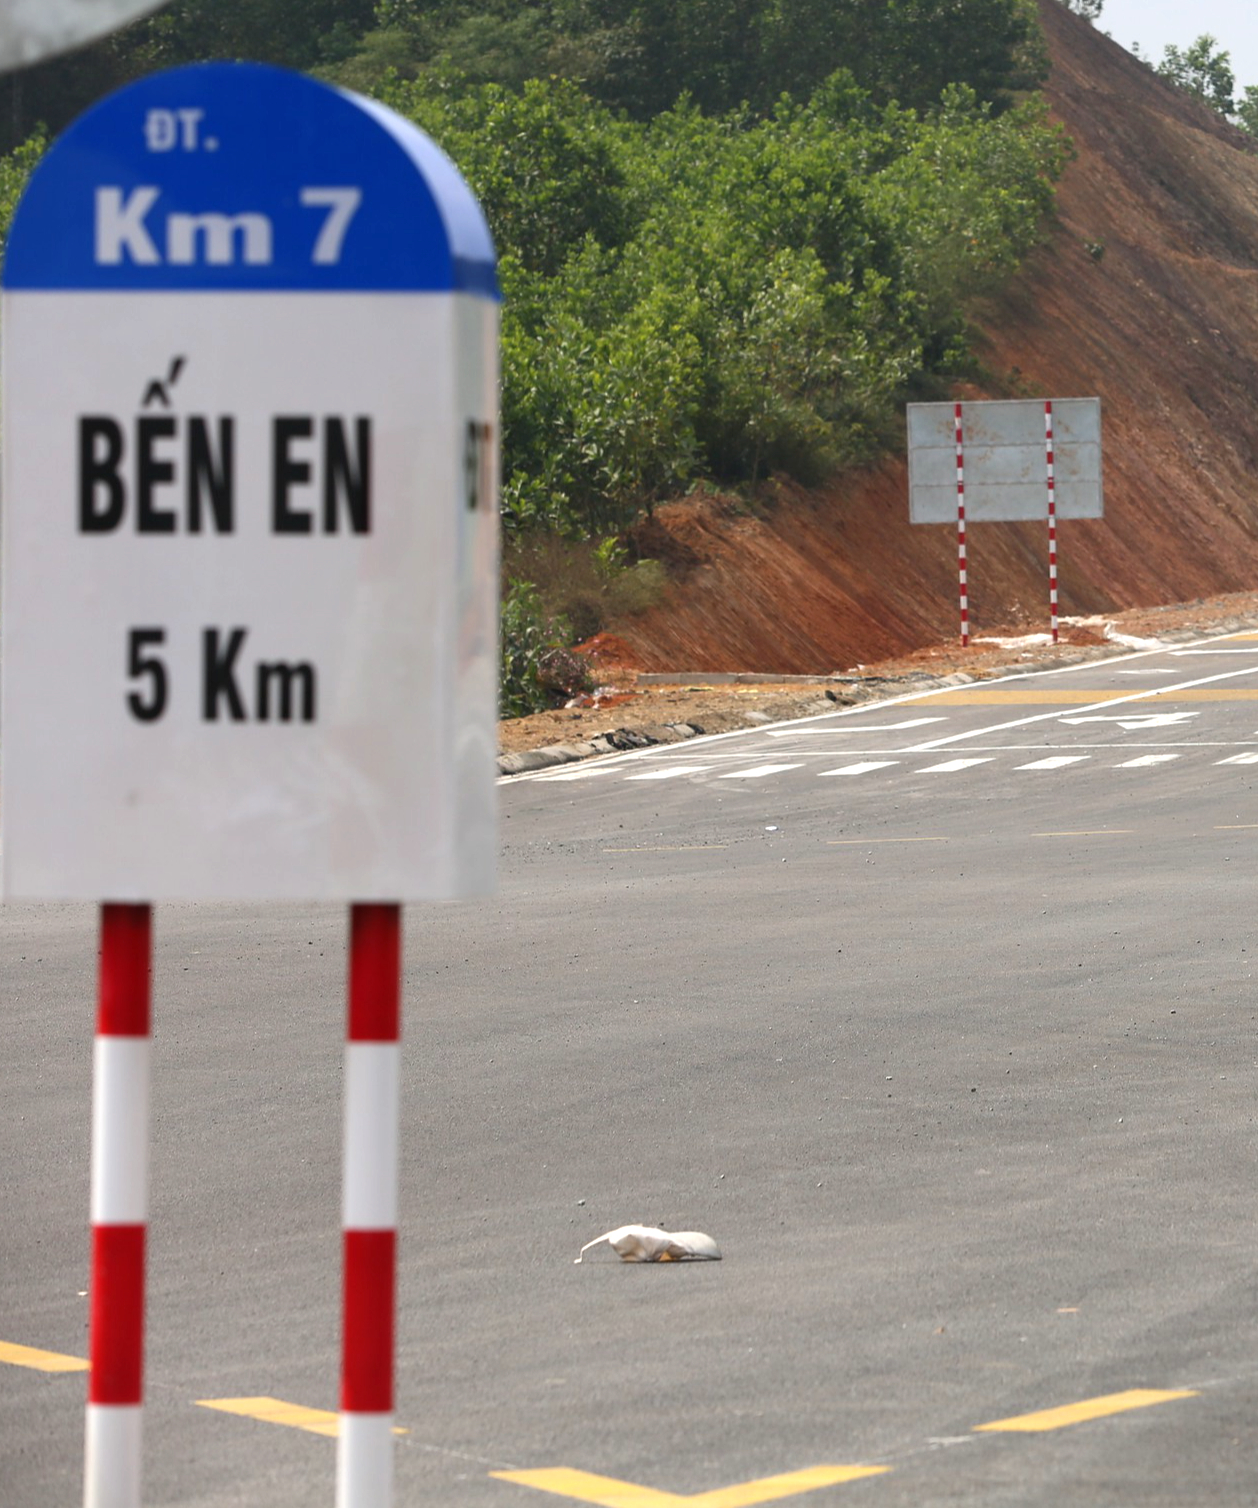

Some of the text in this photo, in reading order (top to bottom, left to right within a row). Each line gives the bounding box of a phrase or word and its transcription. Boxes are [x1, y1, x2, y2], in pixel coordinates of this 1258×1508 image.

[144, 108, 219, 151] ĐT.
[94, 185, 362, 266] Km 7
[77, 355, 236, 536] BẾN
[271, 414, 373, 537] EN
[126, 626, 317, 725] 5 Km
